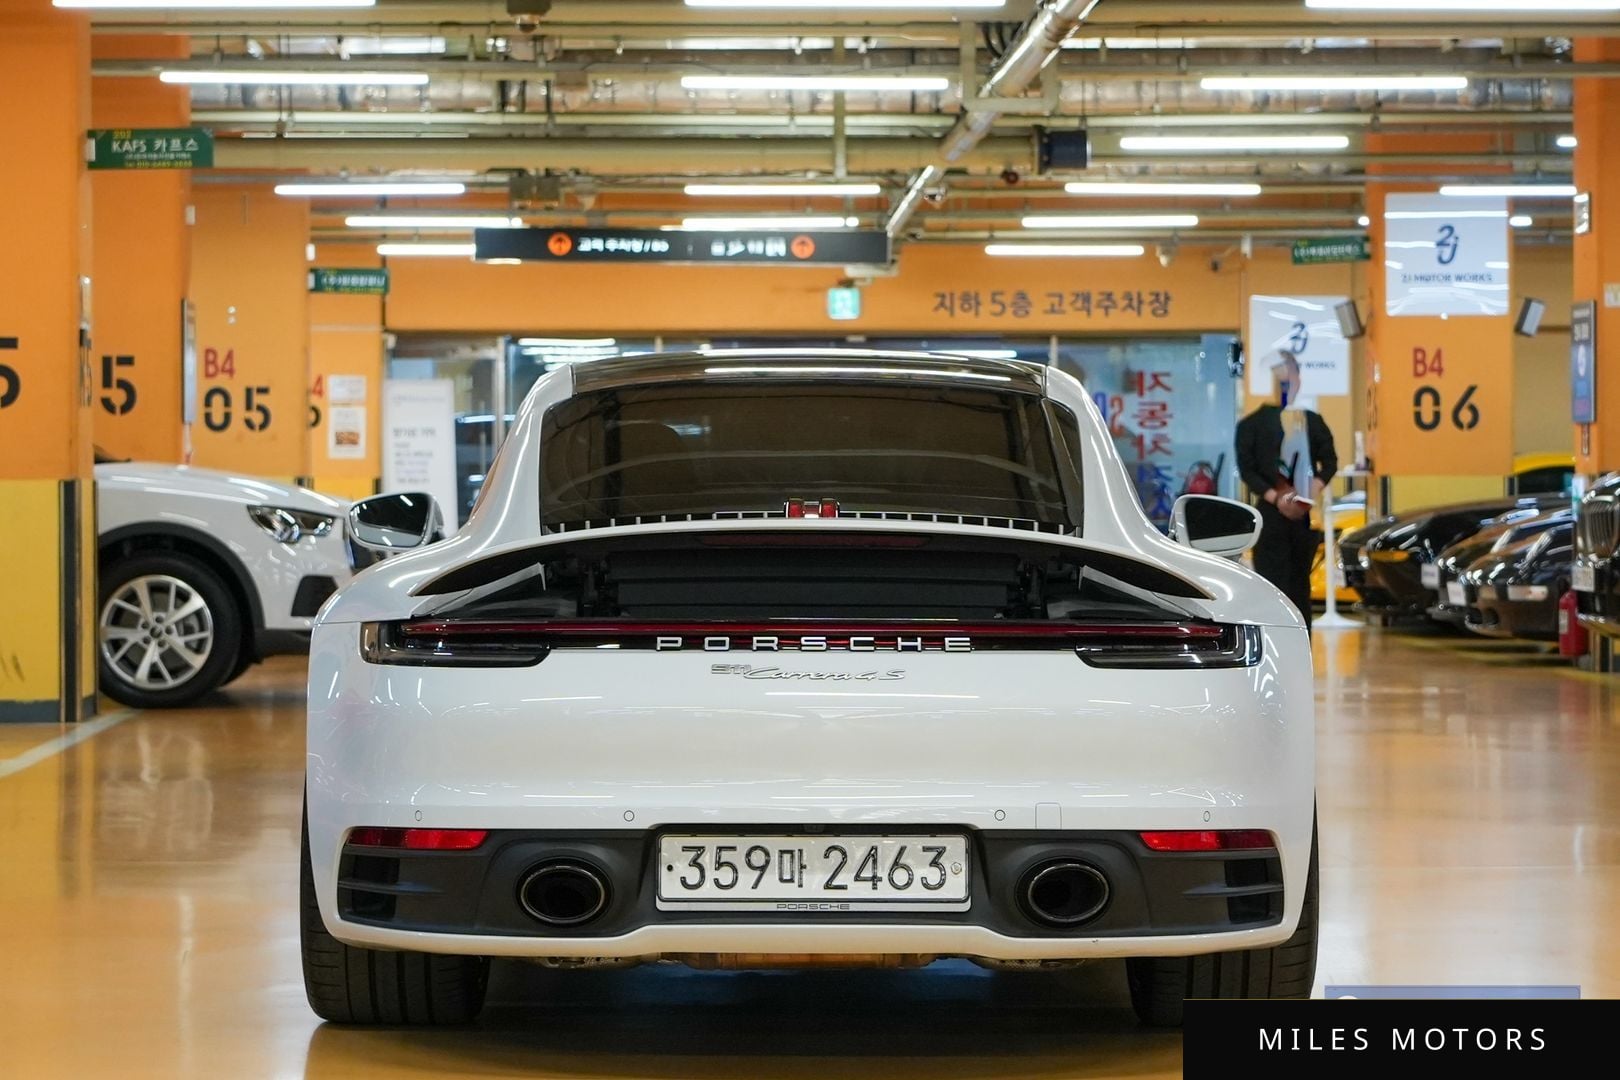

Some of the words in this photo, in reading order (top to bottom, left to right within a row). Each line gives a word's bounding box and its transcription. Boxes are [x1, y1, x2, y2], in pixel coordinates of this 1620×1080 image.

[933, 290, 982, 318] 지하
[204, 348, 235, 378] B4
[1413, 347, 1444, 378] B4
[204, 386, 271, 432] 05
[1414, 385, 1480, 432] 06
[656, 636, 972, 651] PORSCHE
[711, 664, 751, 674] 911
[744, 667, 850, 681] Carrera
[680, 845, 807, 890] 359마
[823, 845, 947, 890] 2463
